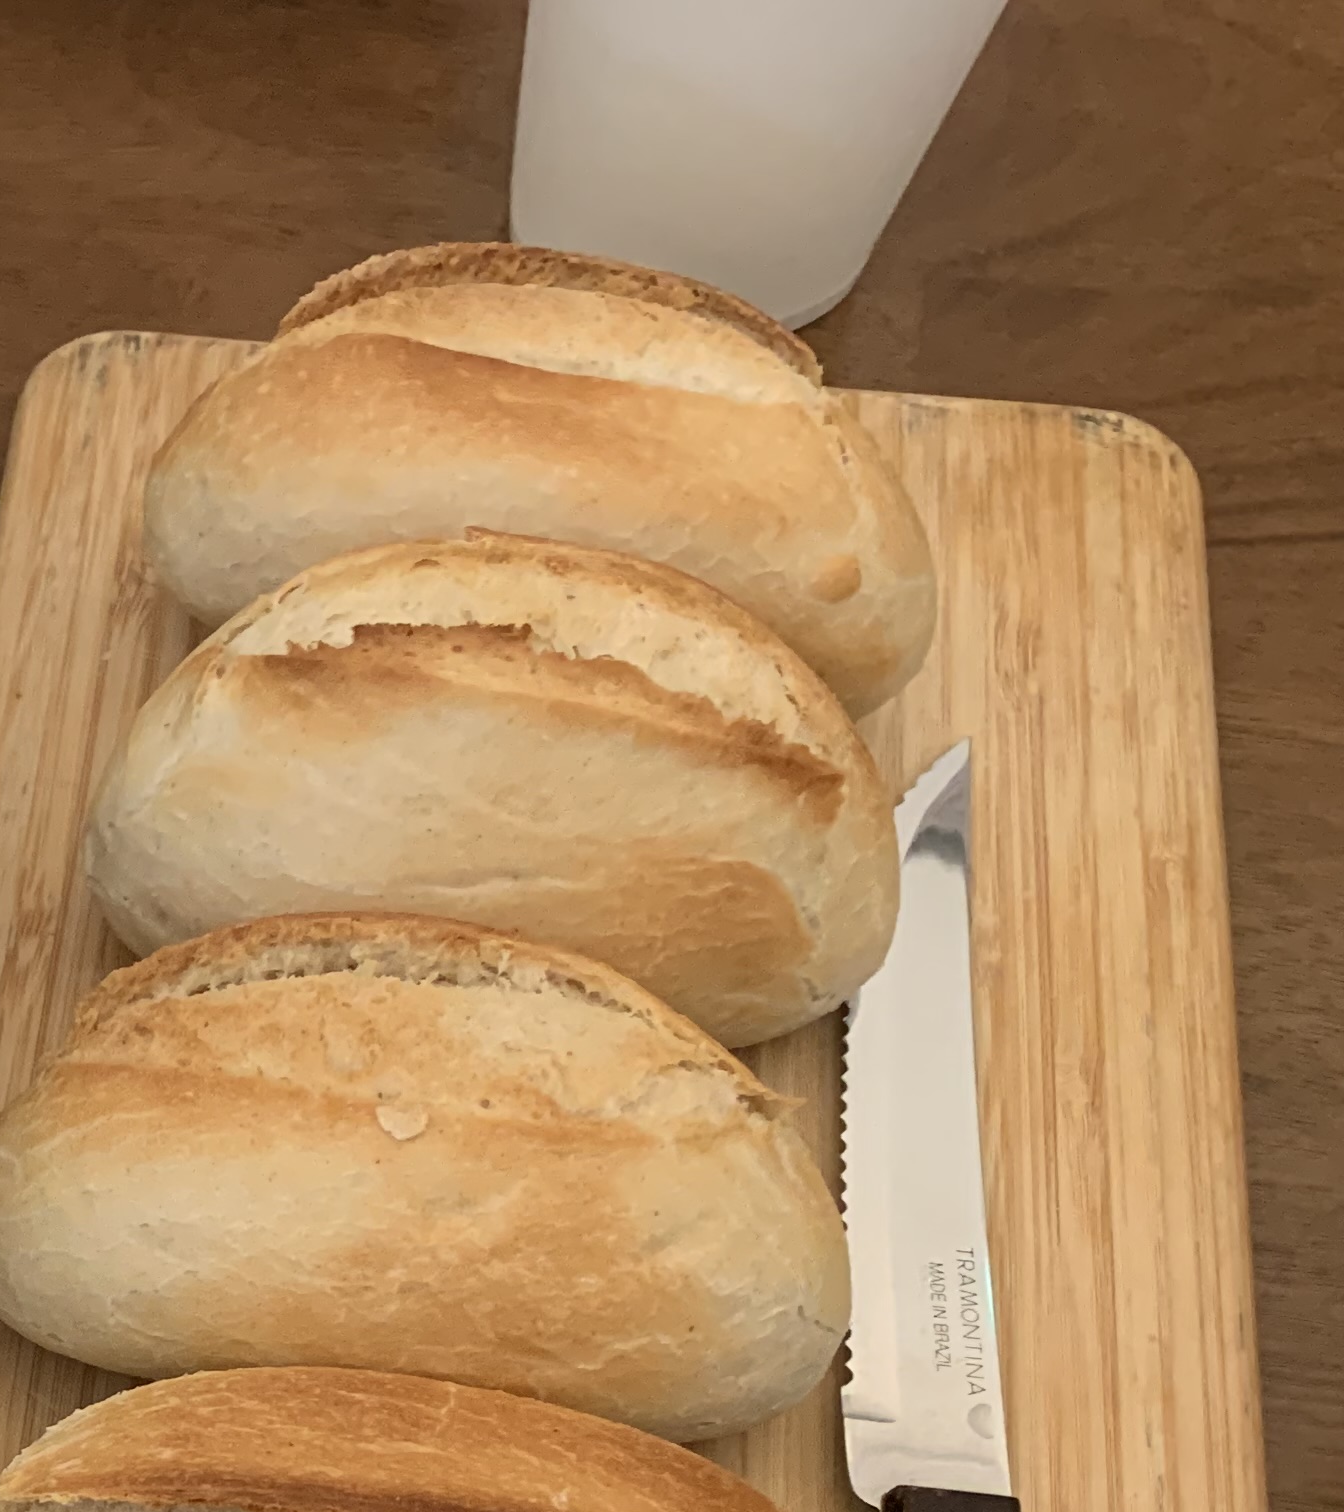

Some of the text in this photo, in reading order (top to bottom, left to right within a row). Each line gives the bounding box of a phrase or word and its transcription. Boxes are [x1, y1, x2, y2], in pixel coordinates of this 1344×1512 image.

[929, 1262, 951, 1371] MADE IN BRAZIL
[956, 1248, 986, 1395] TRAMONTINA
